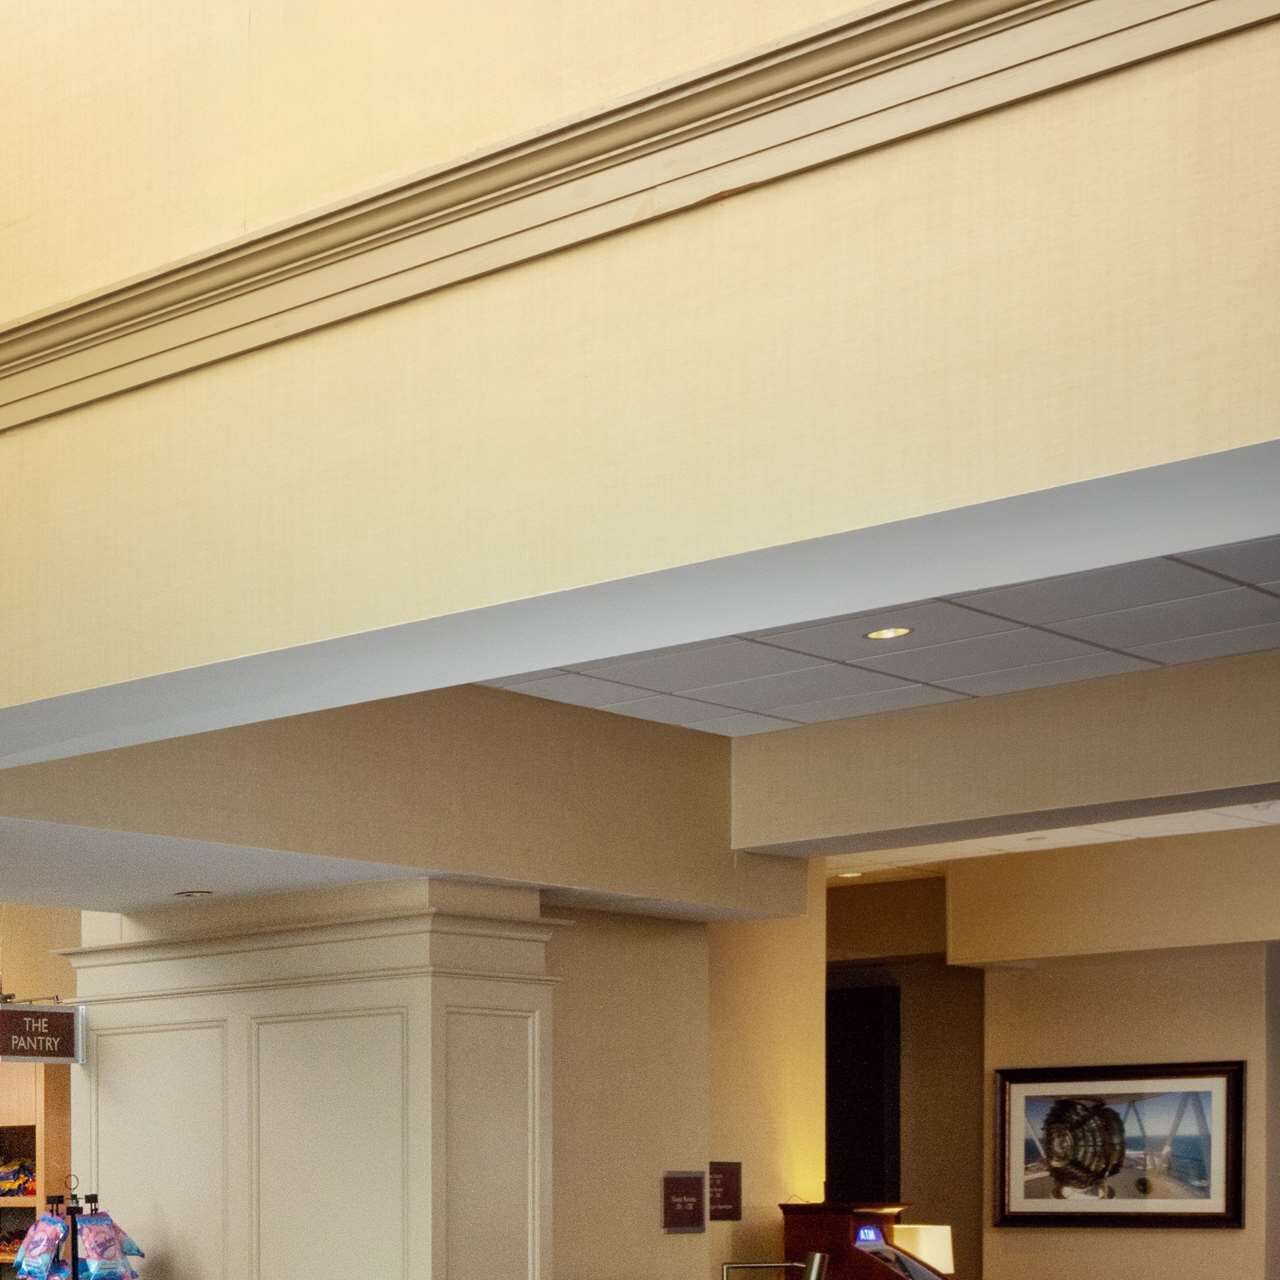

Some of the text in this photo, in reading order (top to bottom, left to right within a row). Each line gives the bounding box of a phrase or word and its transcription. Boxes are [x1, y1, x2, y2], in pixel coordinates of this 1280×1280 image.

[23, 1017, 49, 1033] THE
[11, 1035, 60, 1051] PANTRY
[860, 1229, 876, 1241] ATM
